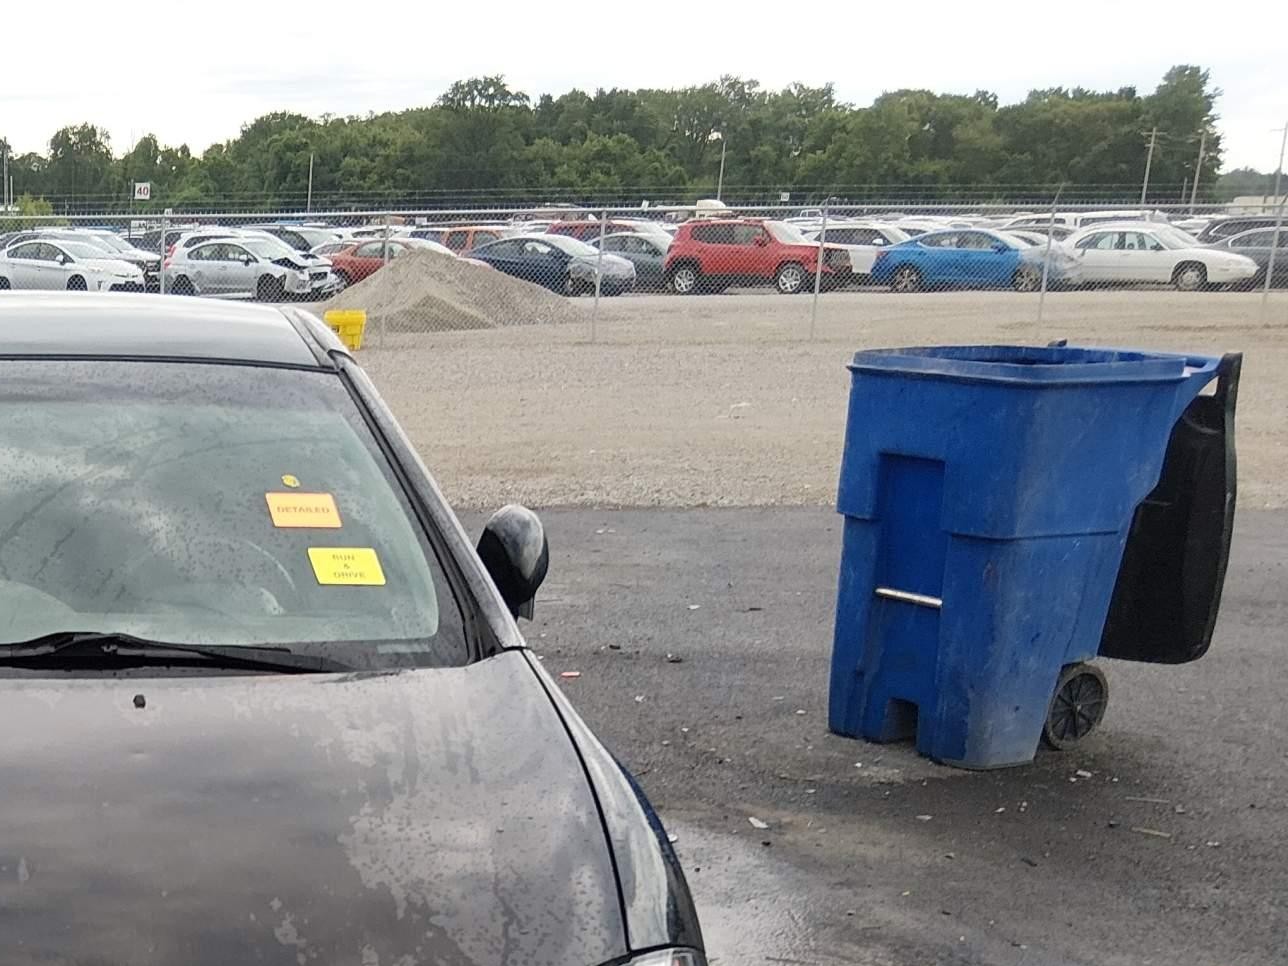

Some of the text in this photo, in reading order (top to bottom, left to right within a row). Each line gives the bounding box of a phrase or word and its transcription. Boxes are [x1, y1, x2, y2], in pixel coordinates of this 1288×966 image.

[137, 186, 149, 196] 40
[276, 505, 330, 514] DETAILED
[331, 553, 355, 561] RUN
[332, 571, 366, 579] DRIVE
